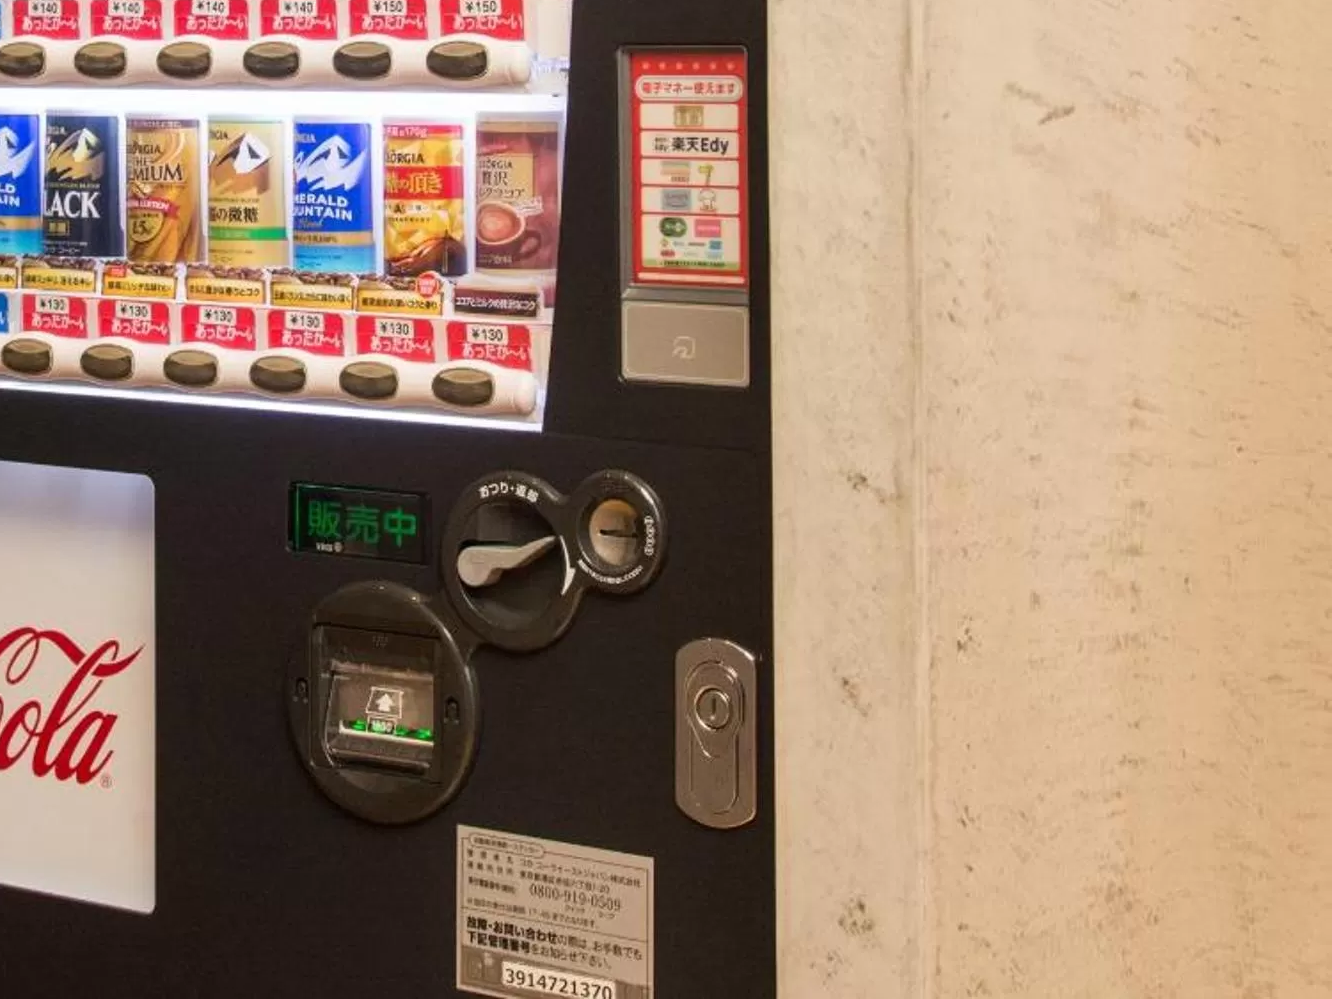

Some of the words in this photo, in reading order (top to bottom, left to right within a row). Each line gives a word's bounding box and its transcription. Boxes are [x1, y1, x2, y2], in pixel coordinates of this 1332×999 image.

[33, 1, 59, 14] ¥140
[113, 1, 141, 14] ¥140
[197, 0, 226, 13] ¥140
[284, 1, 314, 14] ¥140
[373, 0, 403, 14] ¥150
[465, 0, 497, 14] ¥150
[643, 81, 735, 95] 電子マネー使えます
[39, 298, 66, 311] ¥130
[120, 304, 148, 318] ¥130
[204, 308, 234, 323] ¥130
[290, 314, 320, 328] ¥130
[380, 321, 409, 336] ¥130
[471, 327, 504, 342] ¥130
[308, 500, 417, 547] 販売中
[505, 968, 613, 999] 3914721370
